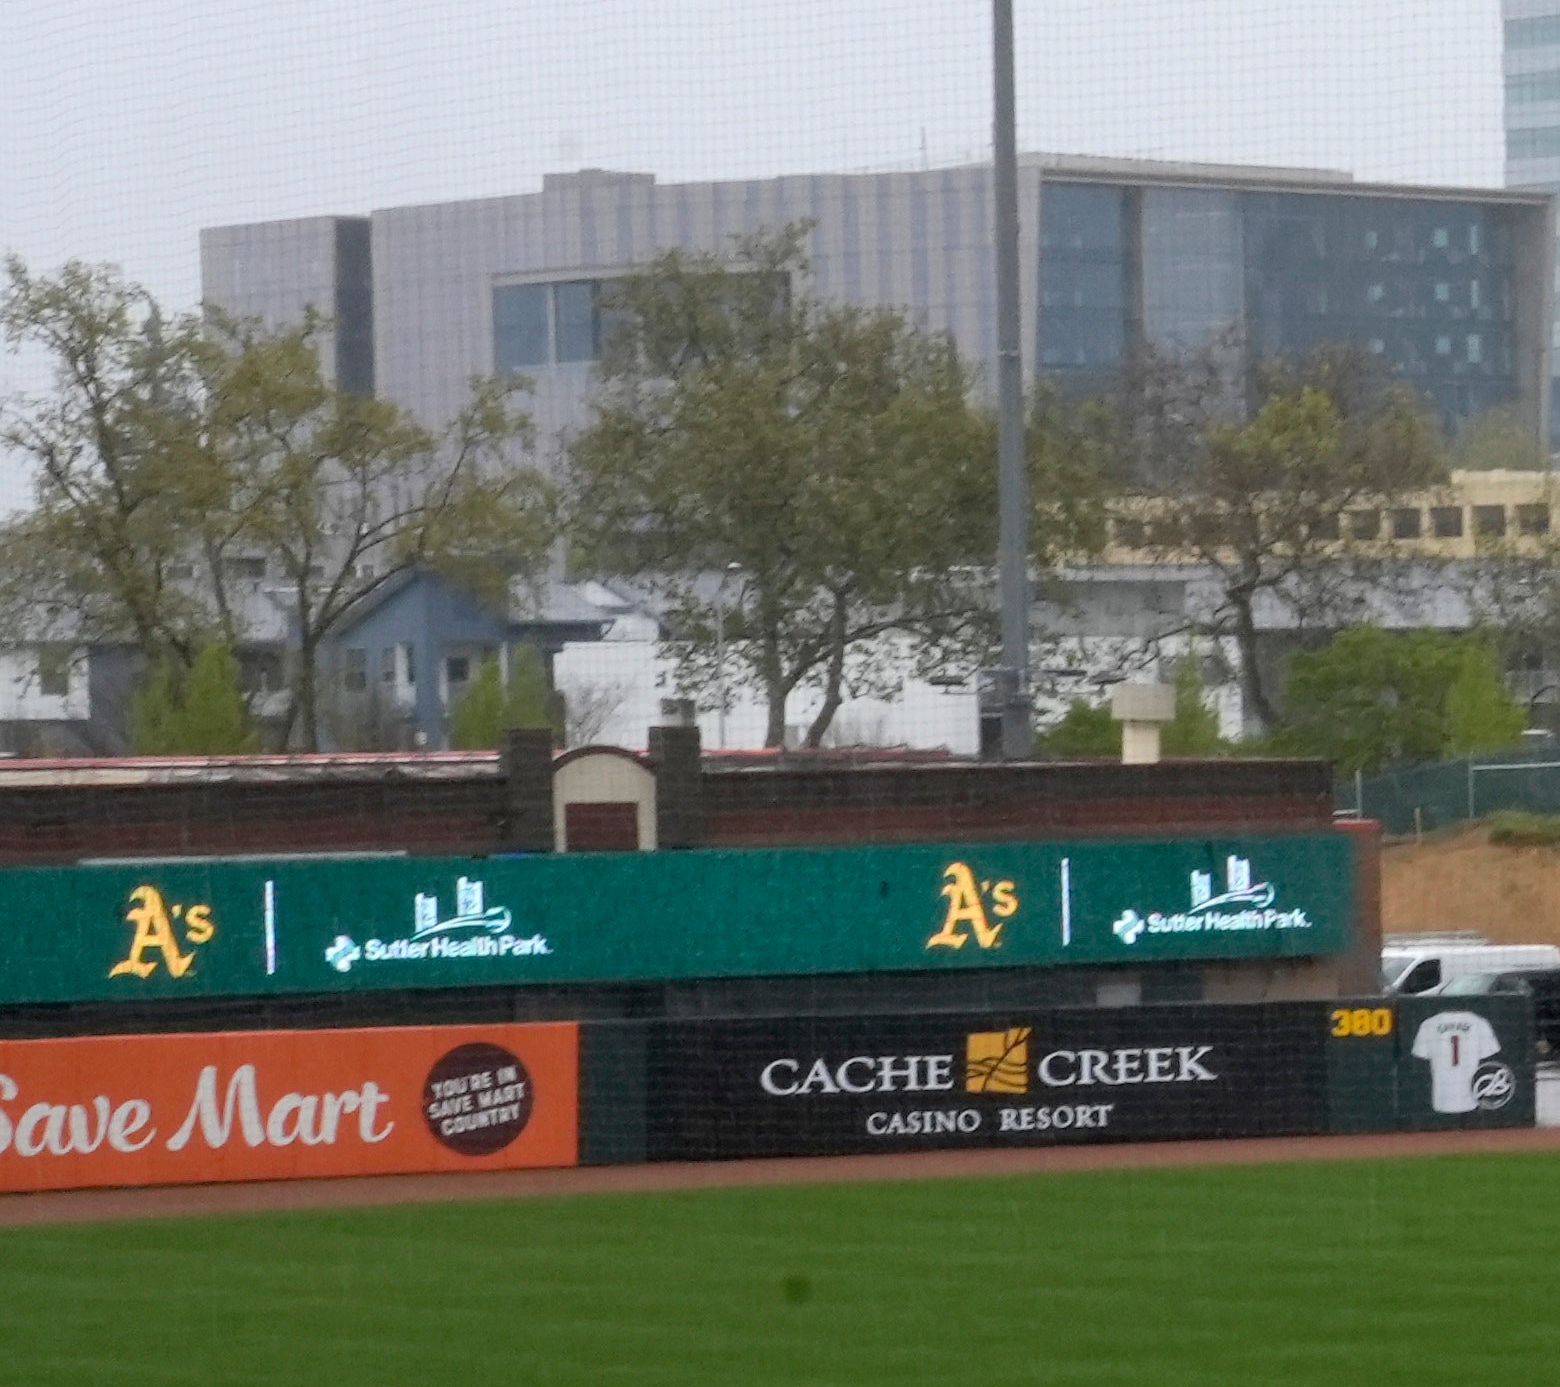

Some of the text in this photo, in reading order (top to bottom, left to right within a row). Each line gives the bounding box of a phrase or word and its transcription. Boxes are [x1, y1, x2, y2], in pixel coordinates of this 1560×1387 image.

[925, 862, 1018, 950] A's
[1147, 913, 1204, 934] Sutter
[1205, 911, 1263, 931] Health
[107, 885, 215, 979] A's
[364, 938, 430, 960] Sutter
[431, 935, 498, 958] Health
[760, 1045, 1218, 1097] CACHE CREEK
[1450, 1035, 1459, 1066] 1
[166, 1062, 395, 1153] Mart
[866, 1103, 1113, 1136] CASINO RESORT
